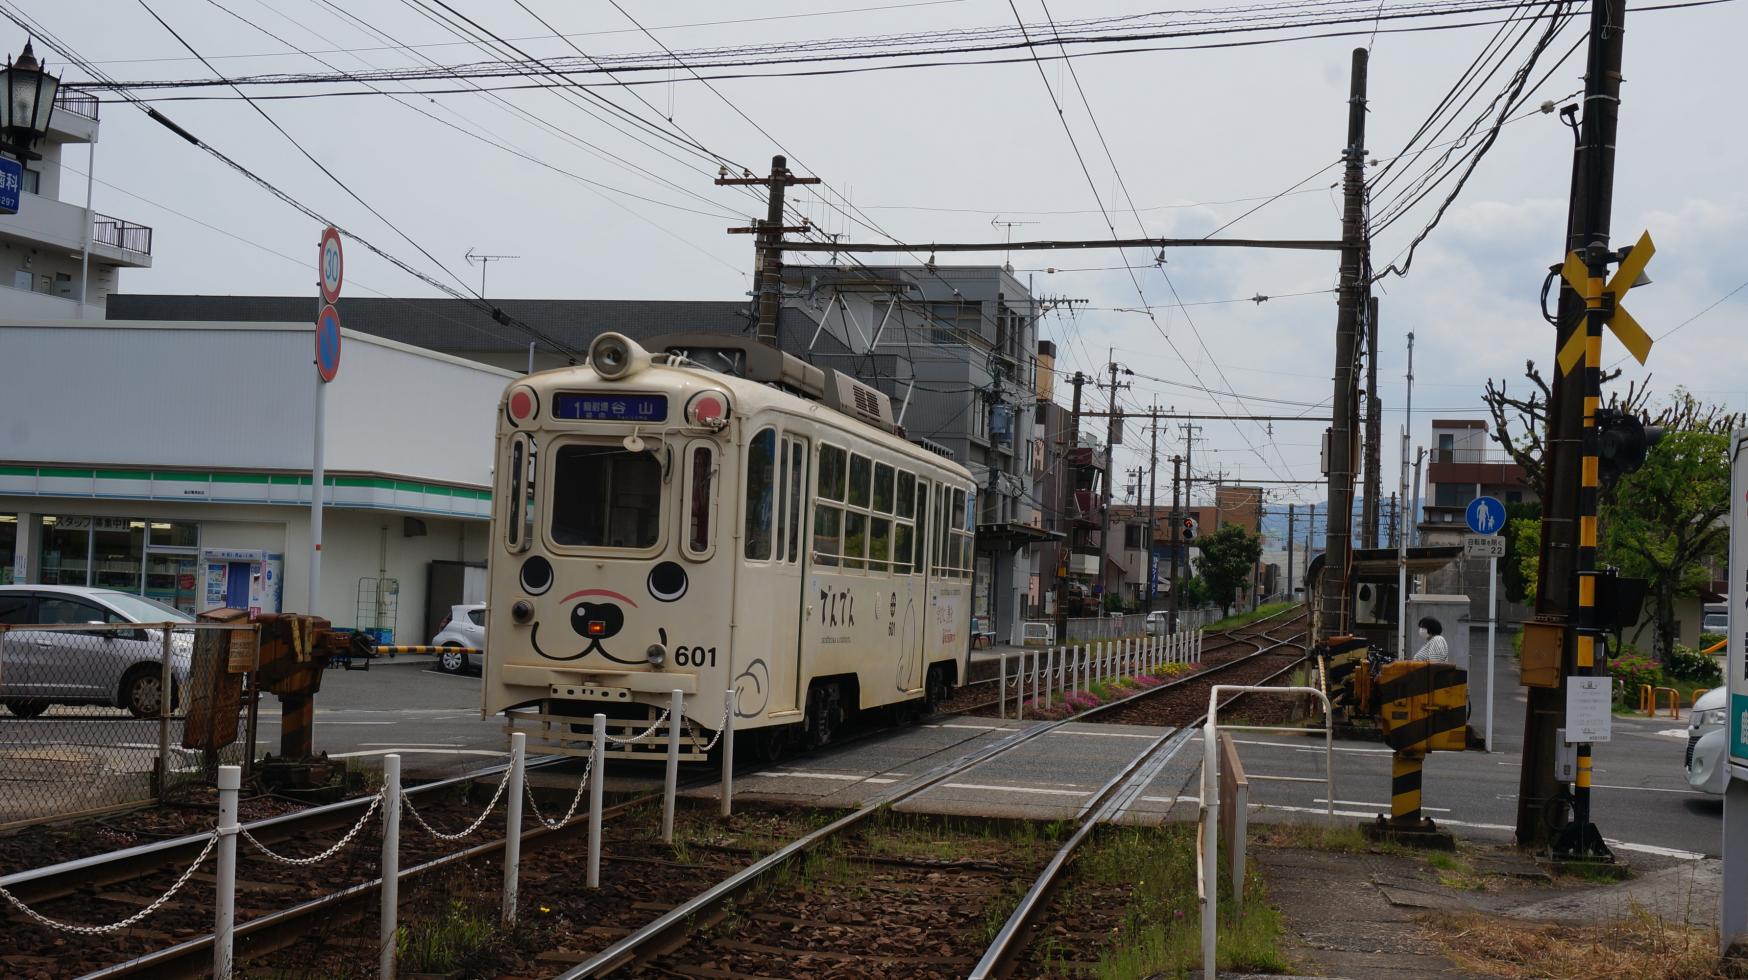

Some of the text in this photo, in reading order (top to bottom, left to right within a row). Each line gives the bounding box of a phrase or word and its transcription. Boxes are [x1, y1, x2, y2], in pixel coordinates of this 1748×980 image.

[0, 196, 15, 207] 297
[325, 247, 339, 282] 30
[574, 401, 580, 419] 1
[820, 584, 855, 628] でんでん
[888, 620, 896, 637] 601
[675, 645, 716, 667] 601
